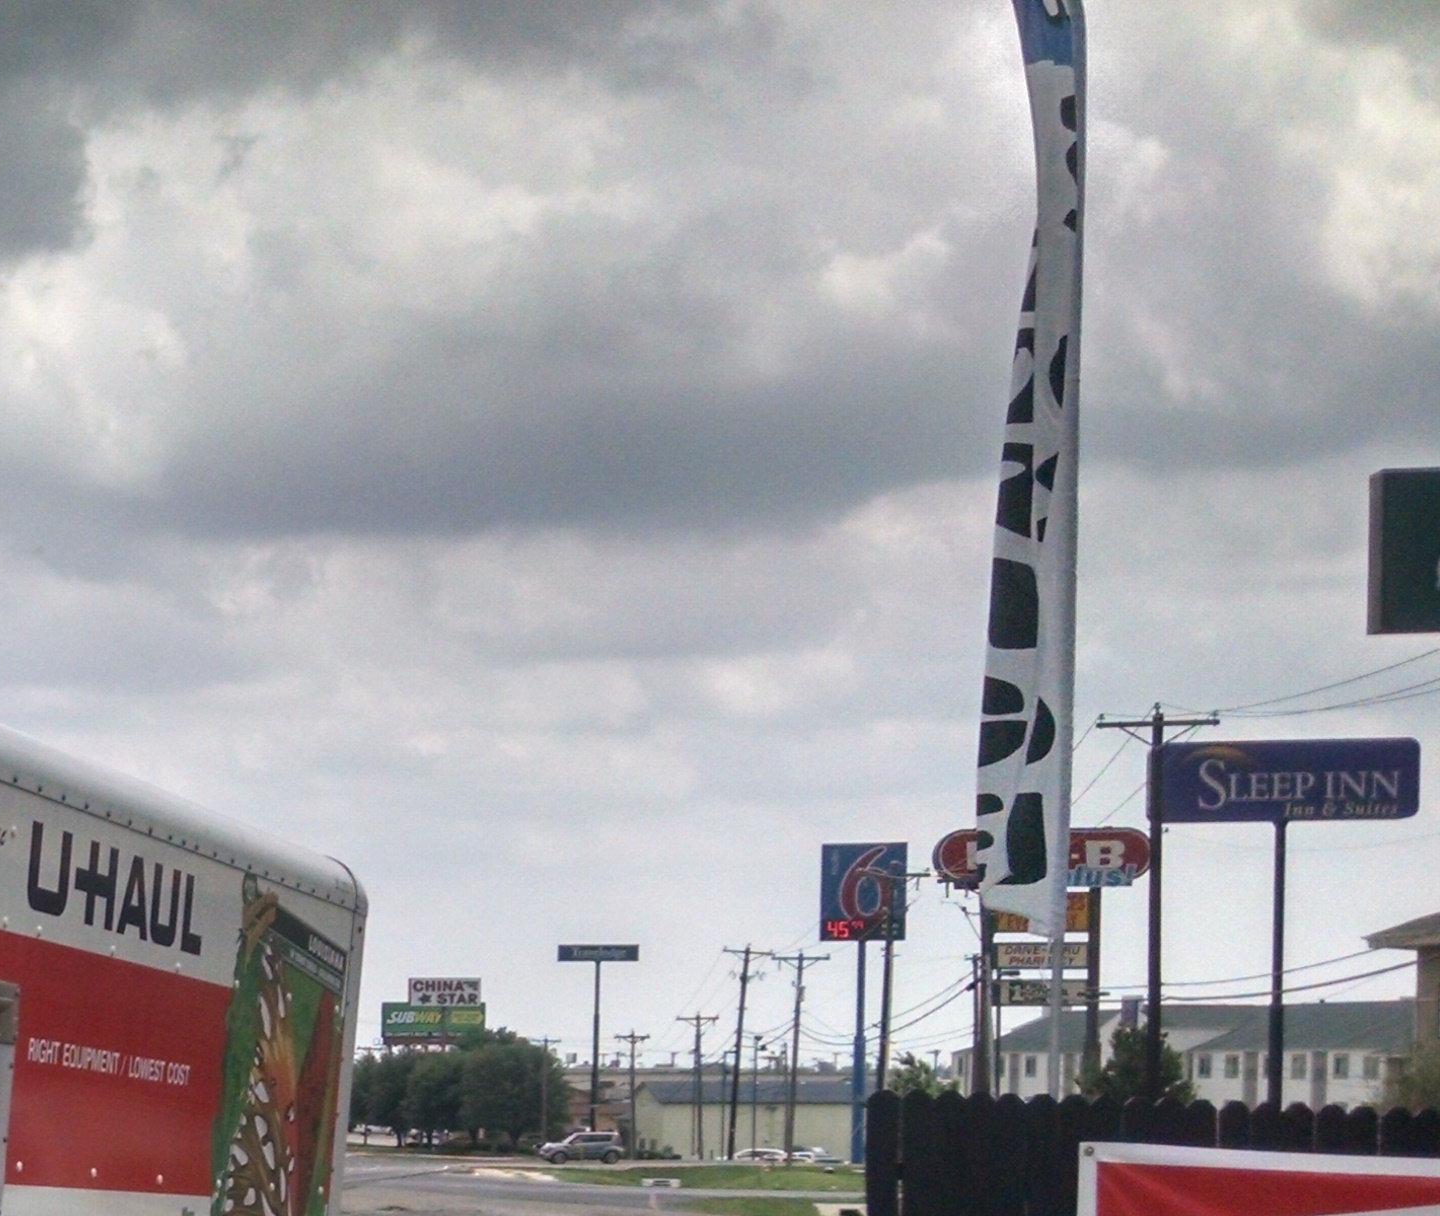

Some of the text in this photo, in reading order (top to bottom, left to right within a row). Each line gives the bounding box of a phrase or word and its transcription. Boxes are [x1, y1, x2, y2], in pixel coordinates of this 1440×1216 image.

[1198, 758, 1400, 811] SLEEP INN
[1284, 800, 1399, 816] Inn & Suites
[413, 980, 465, 992] CHINA
[437, 992, 478, 1005] STAR
[386, 1010, 442, 1024] SUBWAY
[27, 1037, 60, 1065] RIGHT
[62, 1043, 120, 1075] EQUIPMENT
[128, 1056, 166, 1082] LOWEST
[167, 1061, 191, 1086] COST
